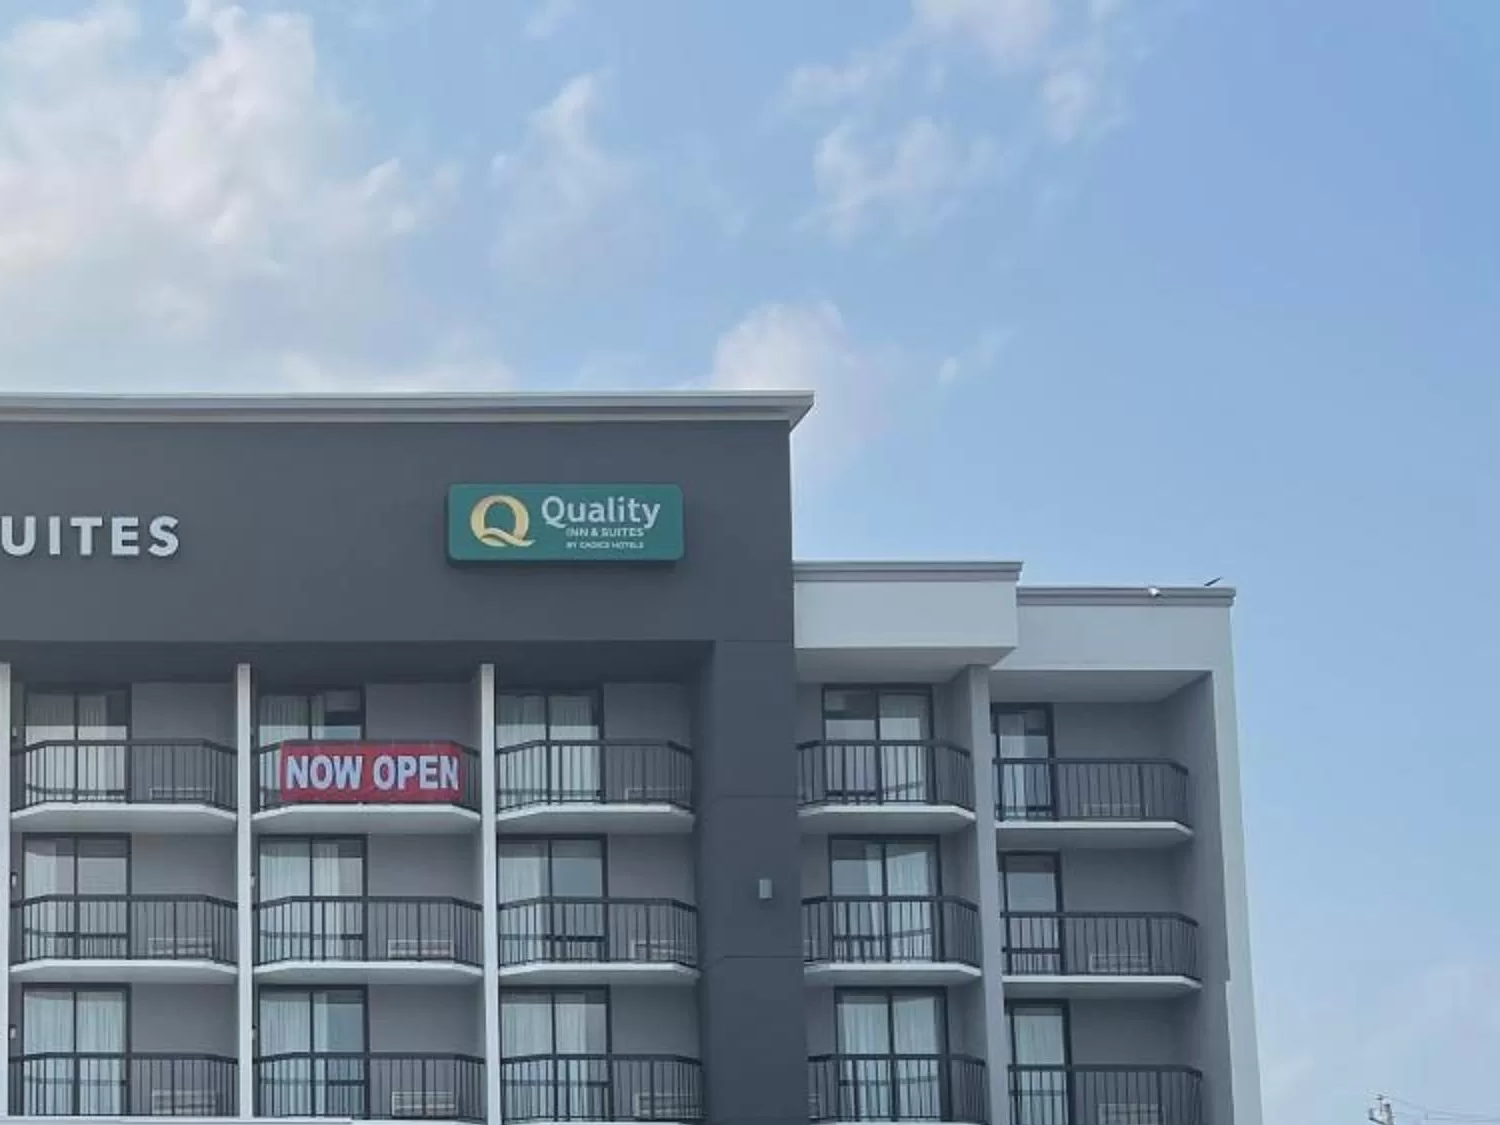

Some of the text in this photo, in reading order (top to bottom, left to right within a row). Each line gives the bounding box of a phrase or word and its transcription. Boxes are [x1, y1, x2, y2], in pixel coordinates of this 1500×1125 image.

[541, 496, 661, 528] Quality
[566, 527, 645, 537] INN & SUITES
[612, 541, 645, 549] HOTELS
[286, 754, 459, 791] NOW OPEN
